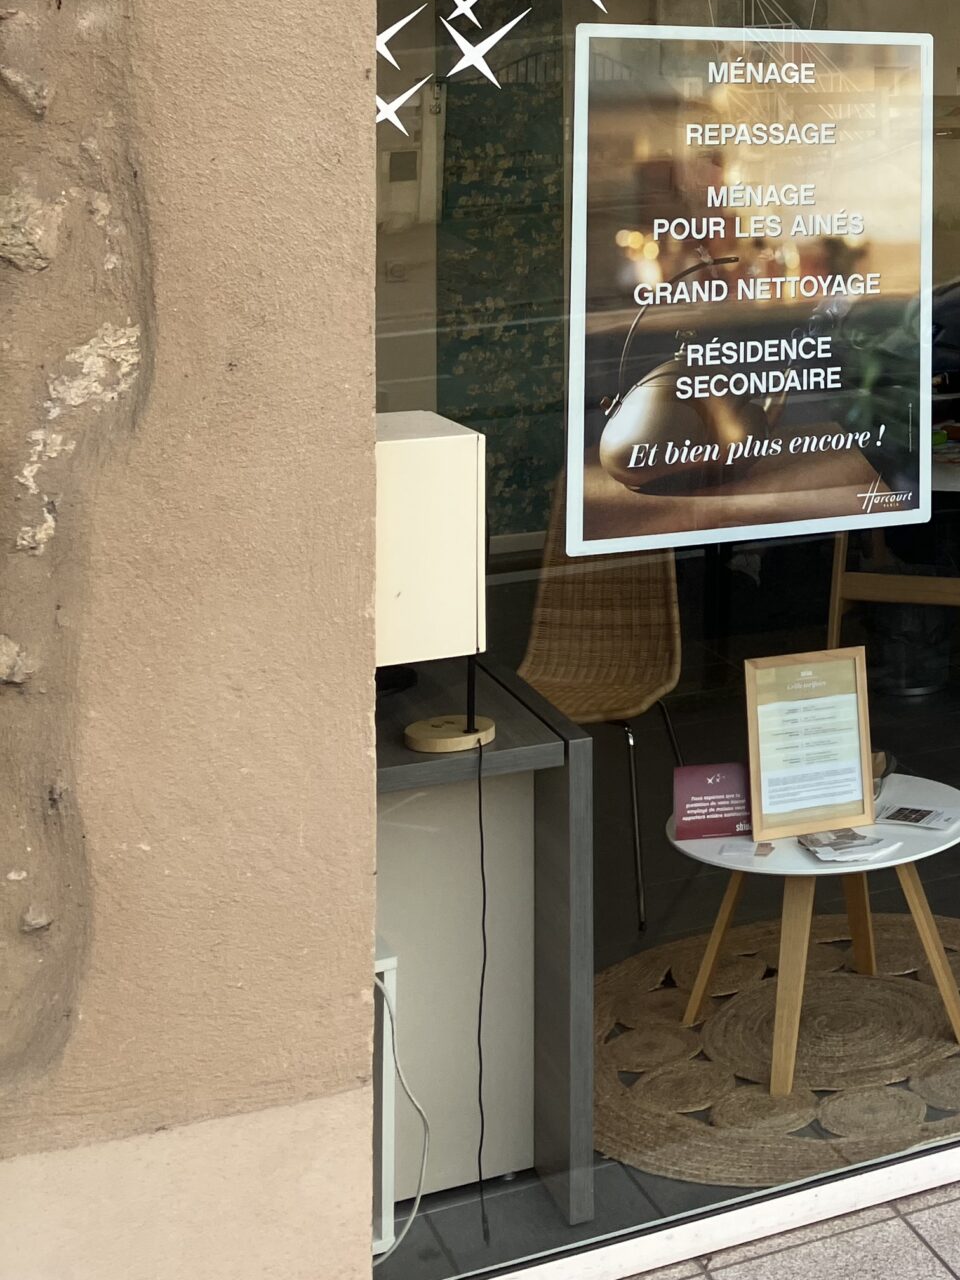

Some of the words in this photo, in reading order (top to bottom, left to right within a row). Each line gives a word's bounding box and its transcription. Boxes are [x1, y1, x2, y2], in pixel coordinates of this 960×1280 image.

[708, 57, 816, 84] MÉNAGE
[686, 122, 837, 146] REPASSAGE
[706, 180, 816, 208] MÉNAGE
[653, 218, 725, 241] POUR
[735, 216, 782, 239] LES
[790, 209, 865, 237] AINÉS
[633, 279, 728, 306] GRAND
[737, 272, 881, 301] NETTOYAGE
[687, 336, 832, 367] RÉSIDENCE
[676, 367, 842, 400] SECONDAIRE
[627, 443, 659, 469] Et
[665, 439, 721, 465] bien
[725, 435, 782, 465] plus
[789, 430, 872, 455] encore
[856, 473, 913, 513] Harcourt
